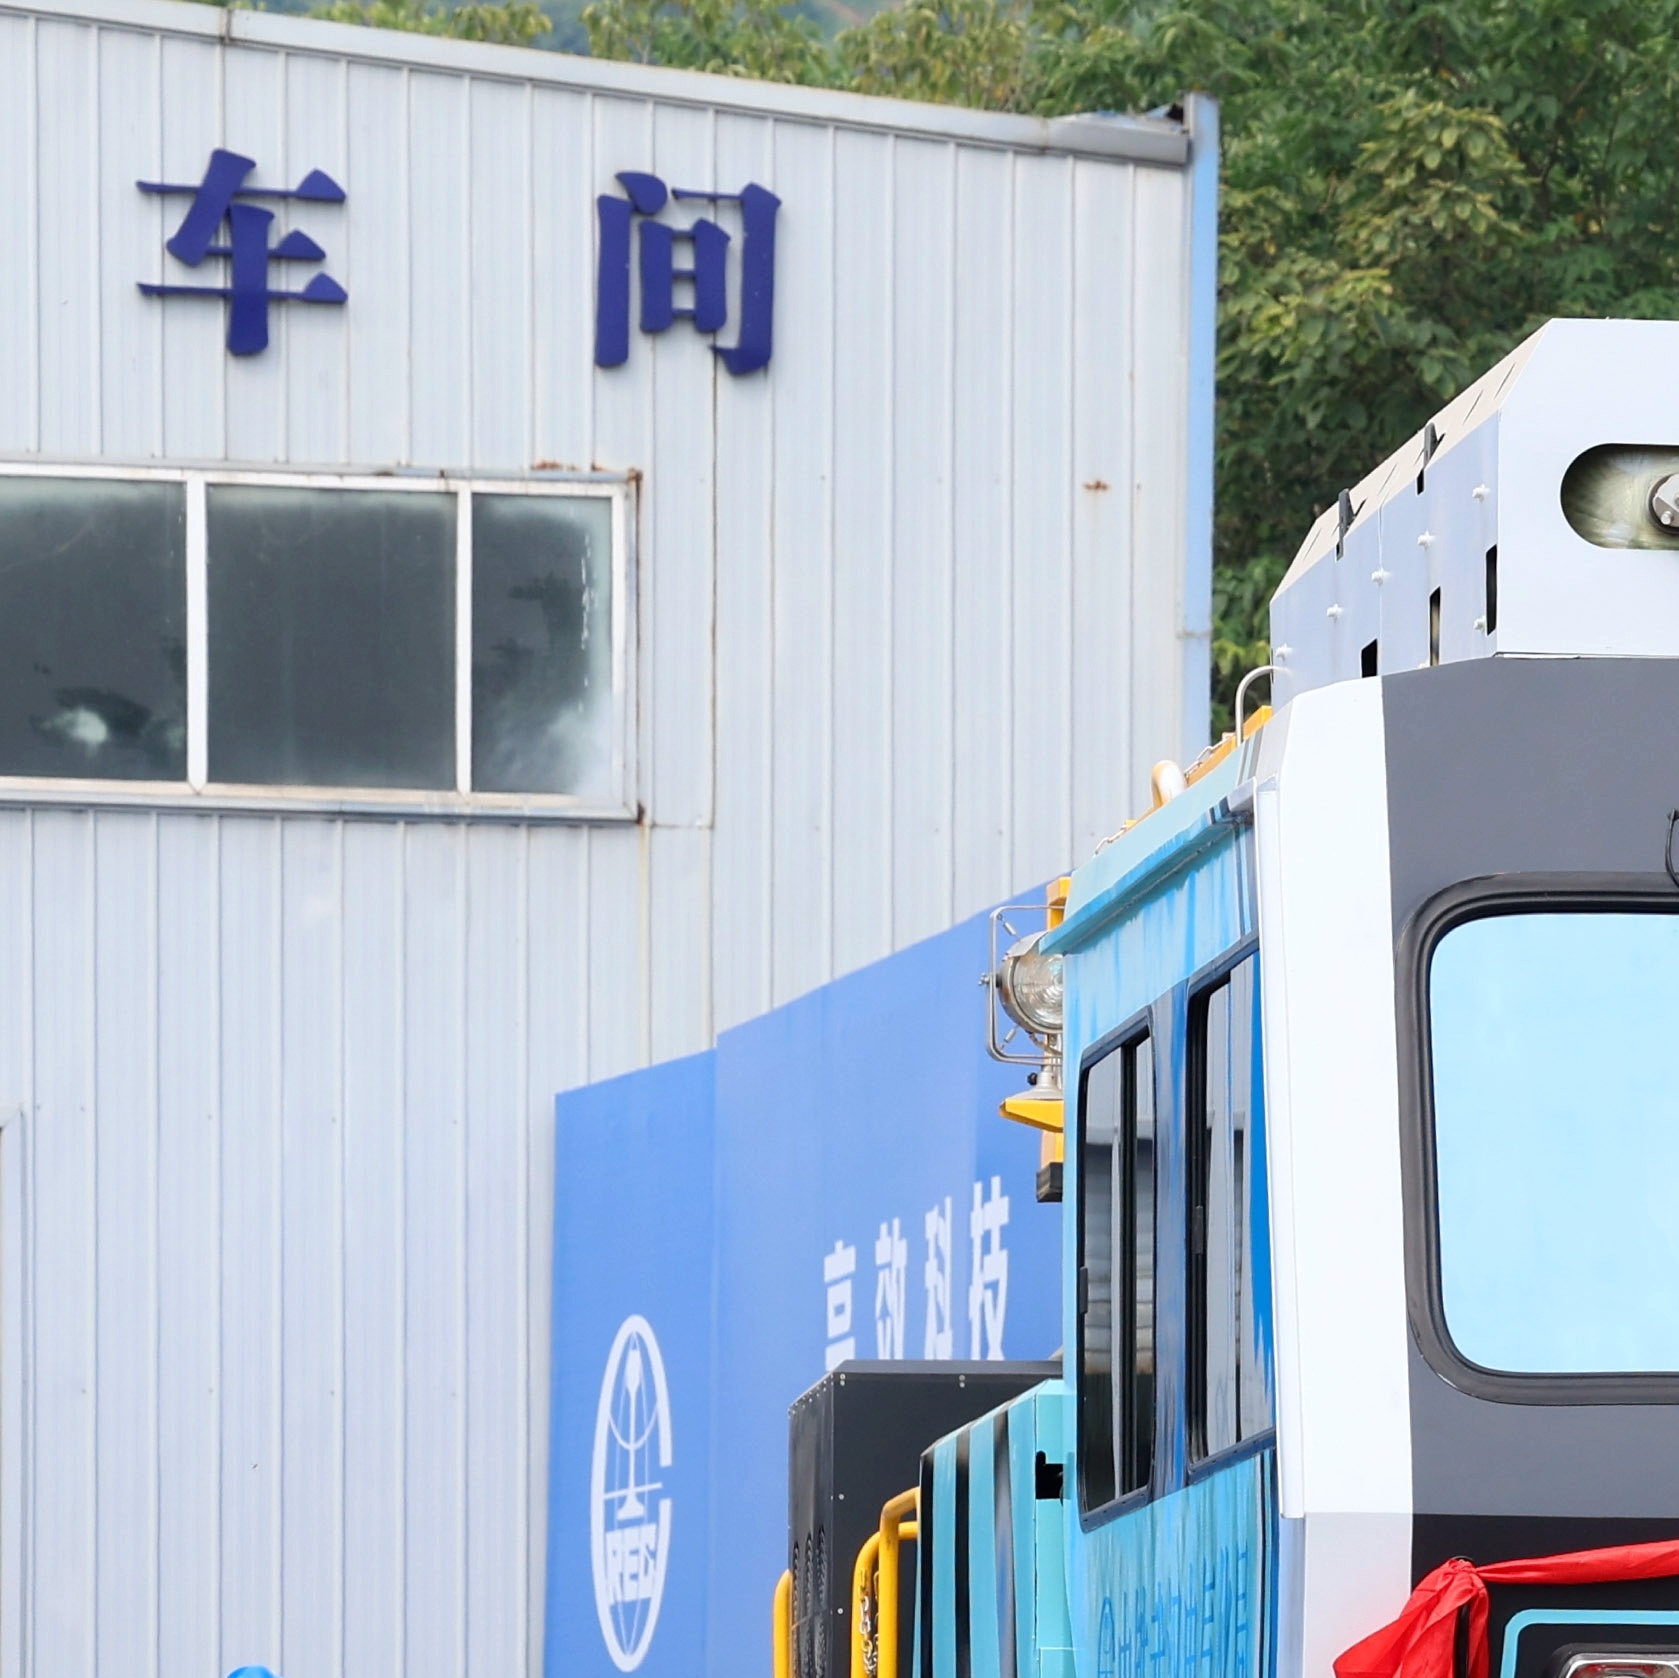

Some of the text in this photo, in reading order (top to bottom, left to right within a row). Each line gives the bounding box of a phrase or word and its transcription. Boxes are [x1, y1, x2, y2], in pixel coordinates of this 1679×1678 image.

[135, 147, 782, 377] 车间
[823, 1174, 1010, 1369] 高效科技
